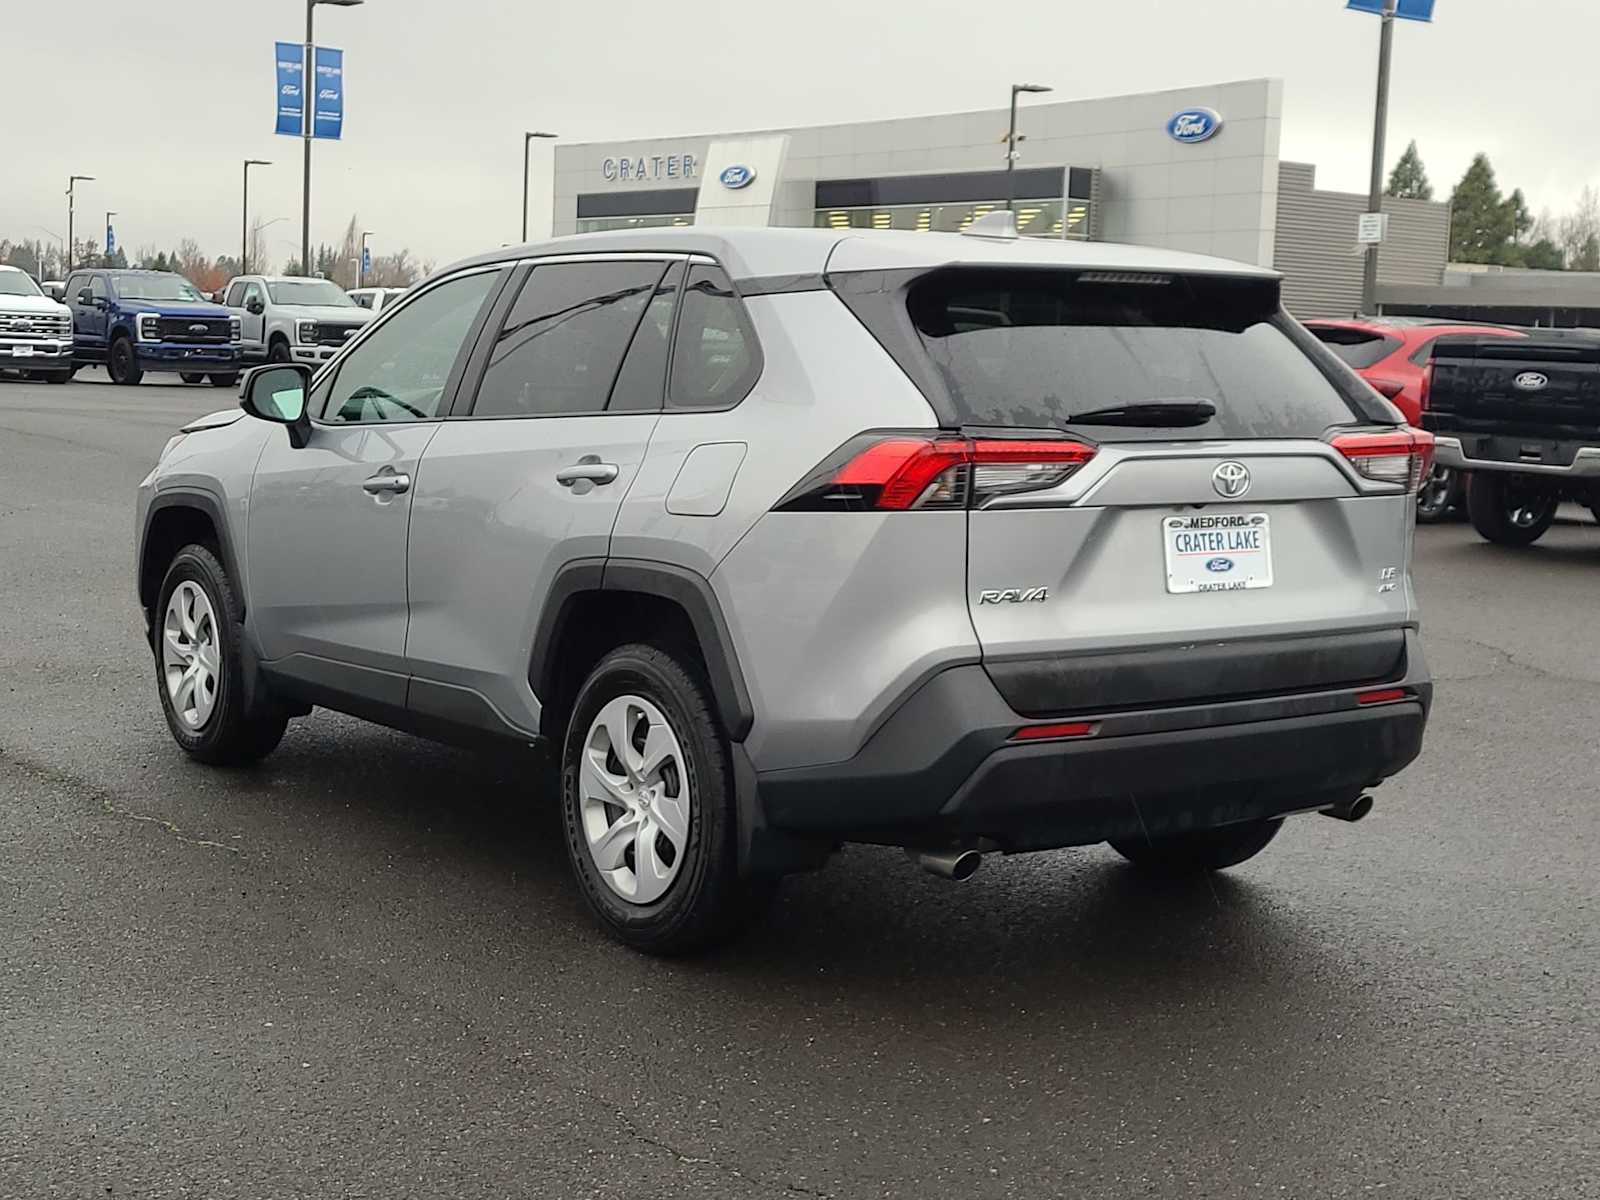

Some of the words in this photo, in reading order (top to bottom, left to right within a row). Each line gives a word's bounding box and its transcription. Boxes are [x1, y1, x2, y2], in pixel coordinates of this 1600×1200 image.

[281, 84, 300, 96] Ford
[319, 88, 339, 100] Ford
[1174, 114, 1207, 137] Ford
[603, 154, 697, 182] CRATER
[1189, 515, 1245, 529] MEDFORD
[1175, 531, 1225, 552] CRATER
[1227, 530, 1261, 550] LAKE
[978, 585, 1049, 605] RAV4
[1198, 582, 1226, 593] CRATER
[1227, 580, 1247, 591] LAKE
